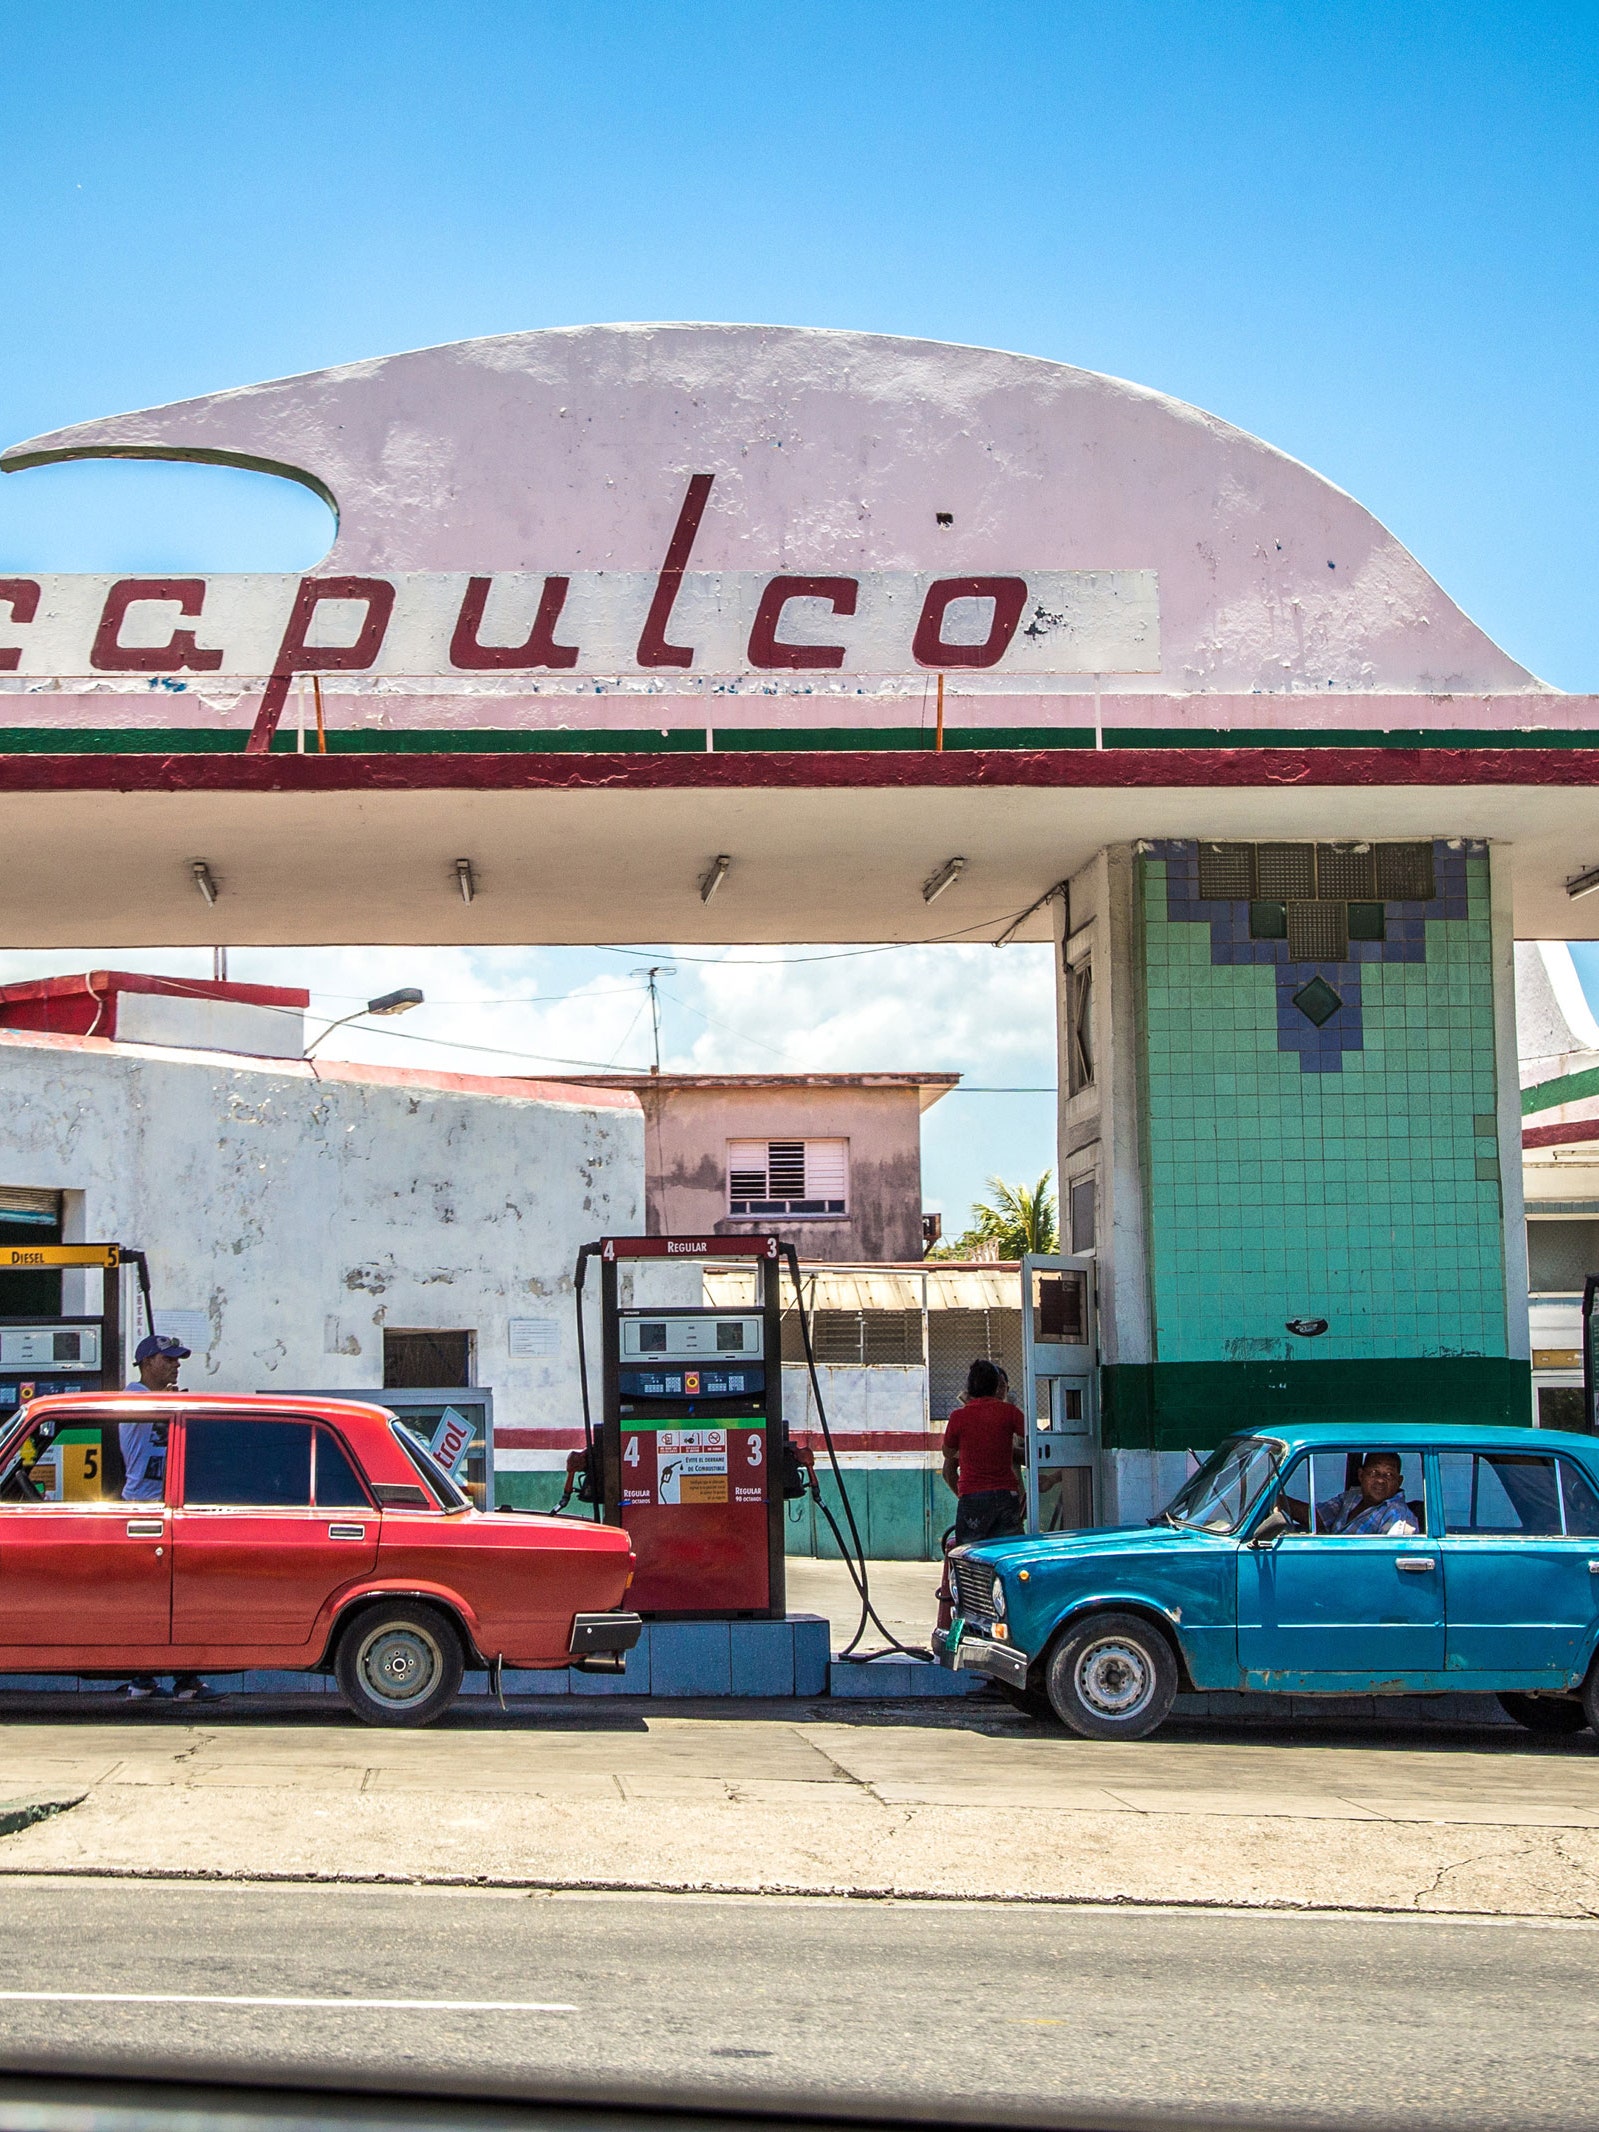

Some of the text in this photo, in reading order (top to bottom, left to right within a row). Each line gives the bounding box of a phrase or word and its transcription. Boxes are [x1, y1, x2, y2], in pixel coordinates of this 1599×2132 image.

[11, 1250, 45, 1264] DIESEL
[107, 1247, 117, 1267] 5
[603, 1240, 615, 1261] 4
[667, 1241, 707, 1253] REGULAR
[767, 1237, 777, 1259] 3
[624, 1436, 640, 1467] 4
[747, 1434, 763, 1466] 3
[83, 1449, 98, 1480] 5
[624, 1489, 650, 1498] REGULAR
[735, 1486, 762, 1495] REGULAR
